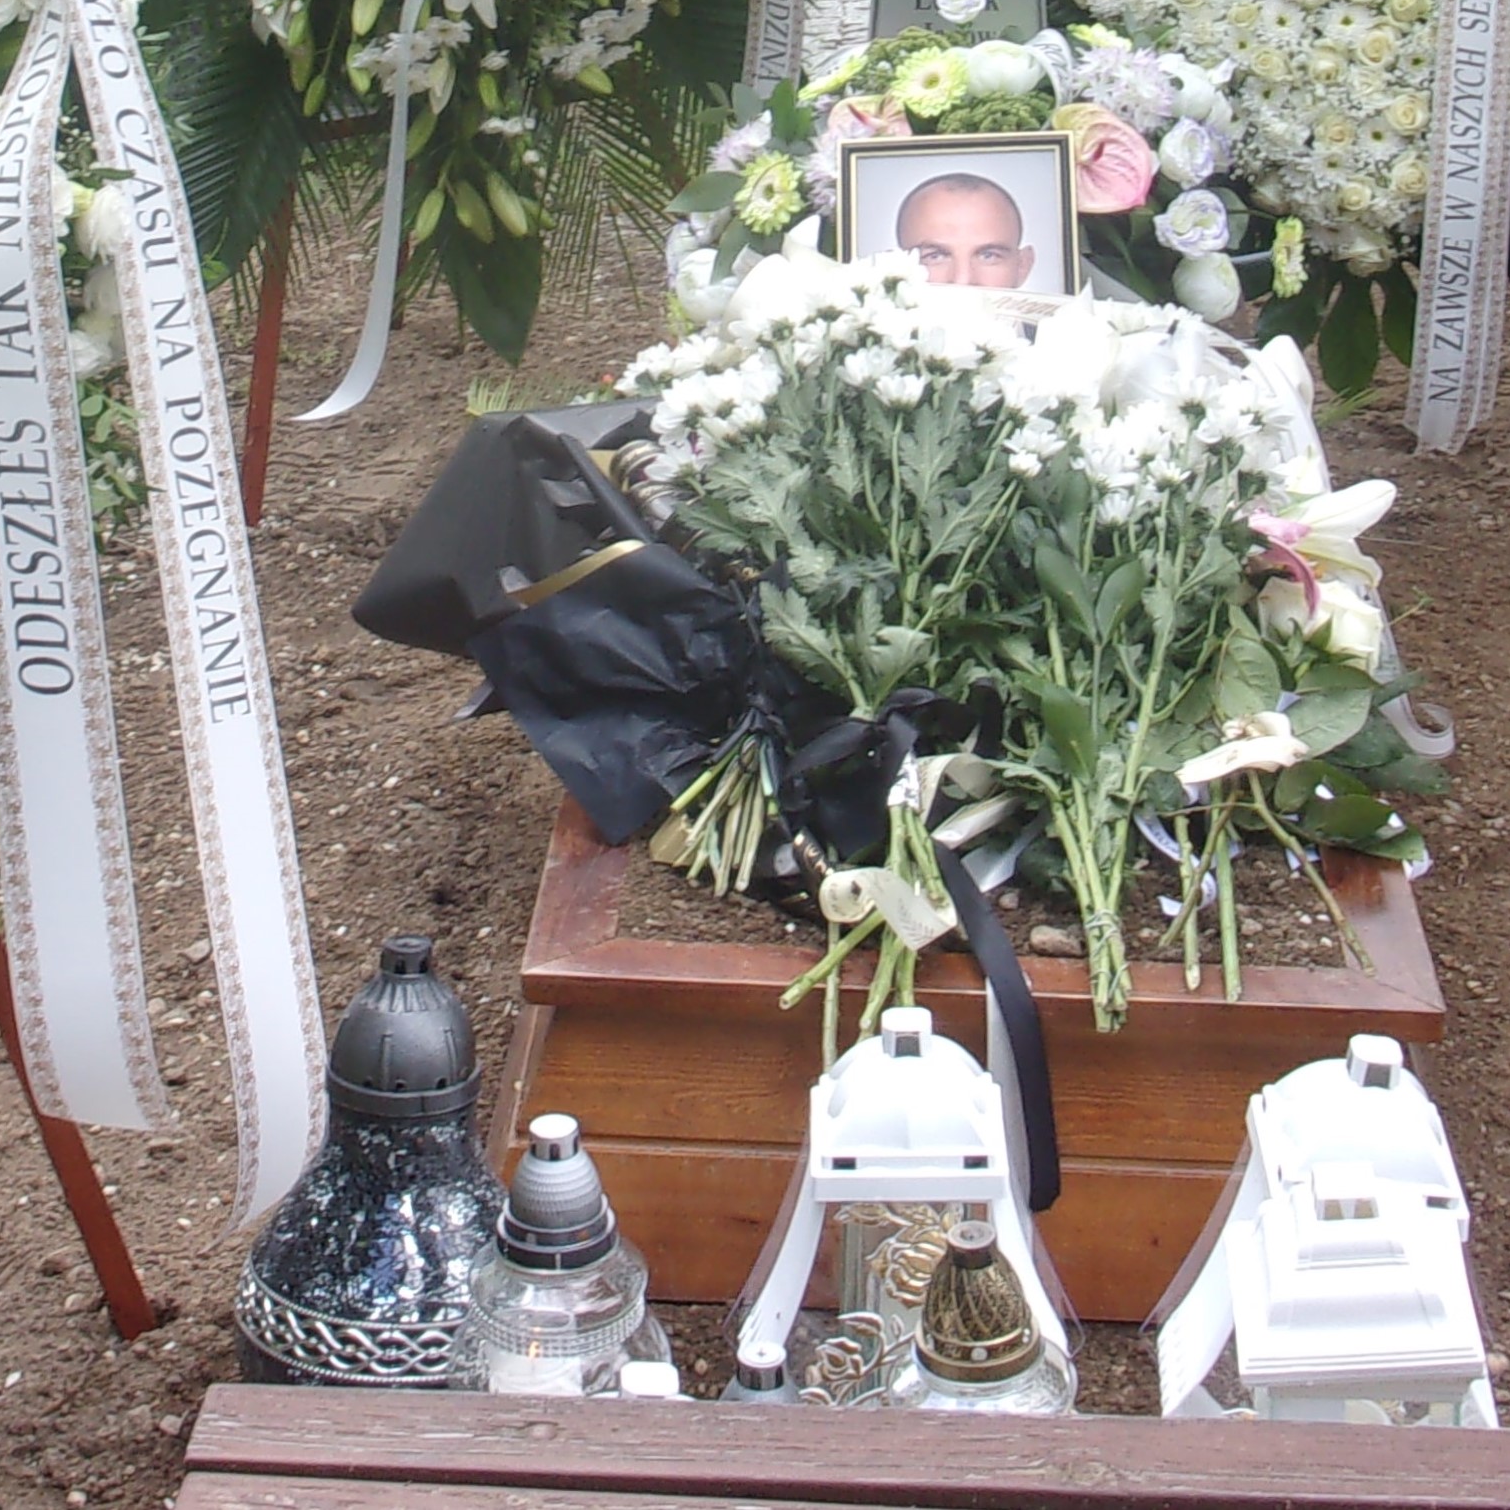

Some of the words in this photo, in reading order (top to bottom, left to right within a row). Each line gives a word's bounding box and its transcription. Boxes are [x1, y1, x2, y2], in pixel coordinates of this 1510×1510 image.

[1446, 47, 1488, 183] NASZYCH
[114, 108, 180, 274] CZASU
[150, 293, 195, 371] NA
[1443, 194, 1477, 222] W
[1433, 237, 1473, 352] ZAWSZE
[1428, 364, 1461, 403] NA
